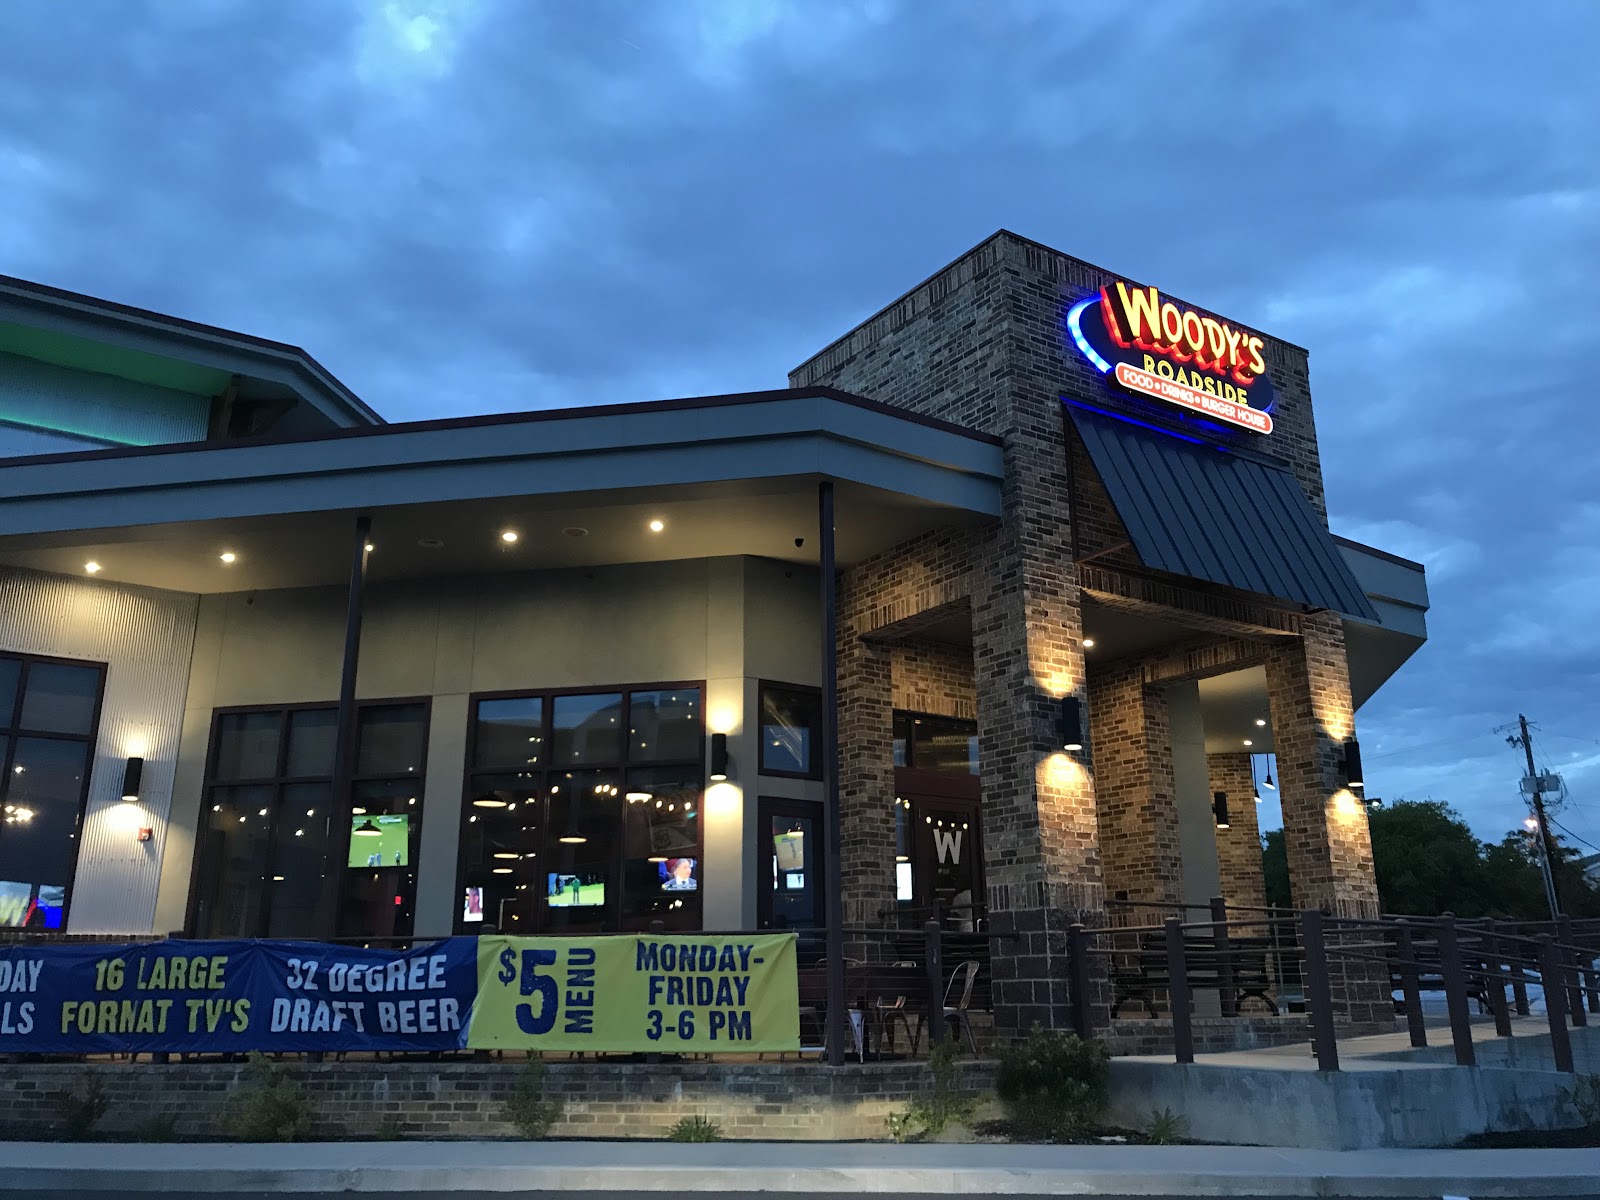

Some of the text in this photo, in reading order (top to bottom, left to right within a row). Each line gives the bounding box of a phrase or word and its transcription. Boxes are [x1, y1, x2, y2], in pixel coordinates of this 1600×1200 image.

[1114, 281, 1266, 375] WOODY'S
[1143, 353, 1249, 407] ROADSIDE
[1123, 369, 1266, 429] FOOD DRINKS BURGER HOUSE
[933, 828, 962, 865] W
[95, 956, 229, 991] 16 LARGE
[286, 954, 447, 993] 32 DEGREE
[636, 939, 765, 972] MONDAY-
[498, 946, 559, 1035] $5
[564, 948, 596, 1034] MENU
[648, 975, 751, 1006] FRIDAY
[61, 998, 251, 1034] FORMAT TV'S
[270, 998, 460, 1034] DRAFT BEER
[646, 1009, 752, 1041] 3-6 PM
